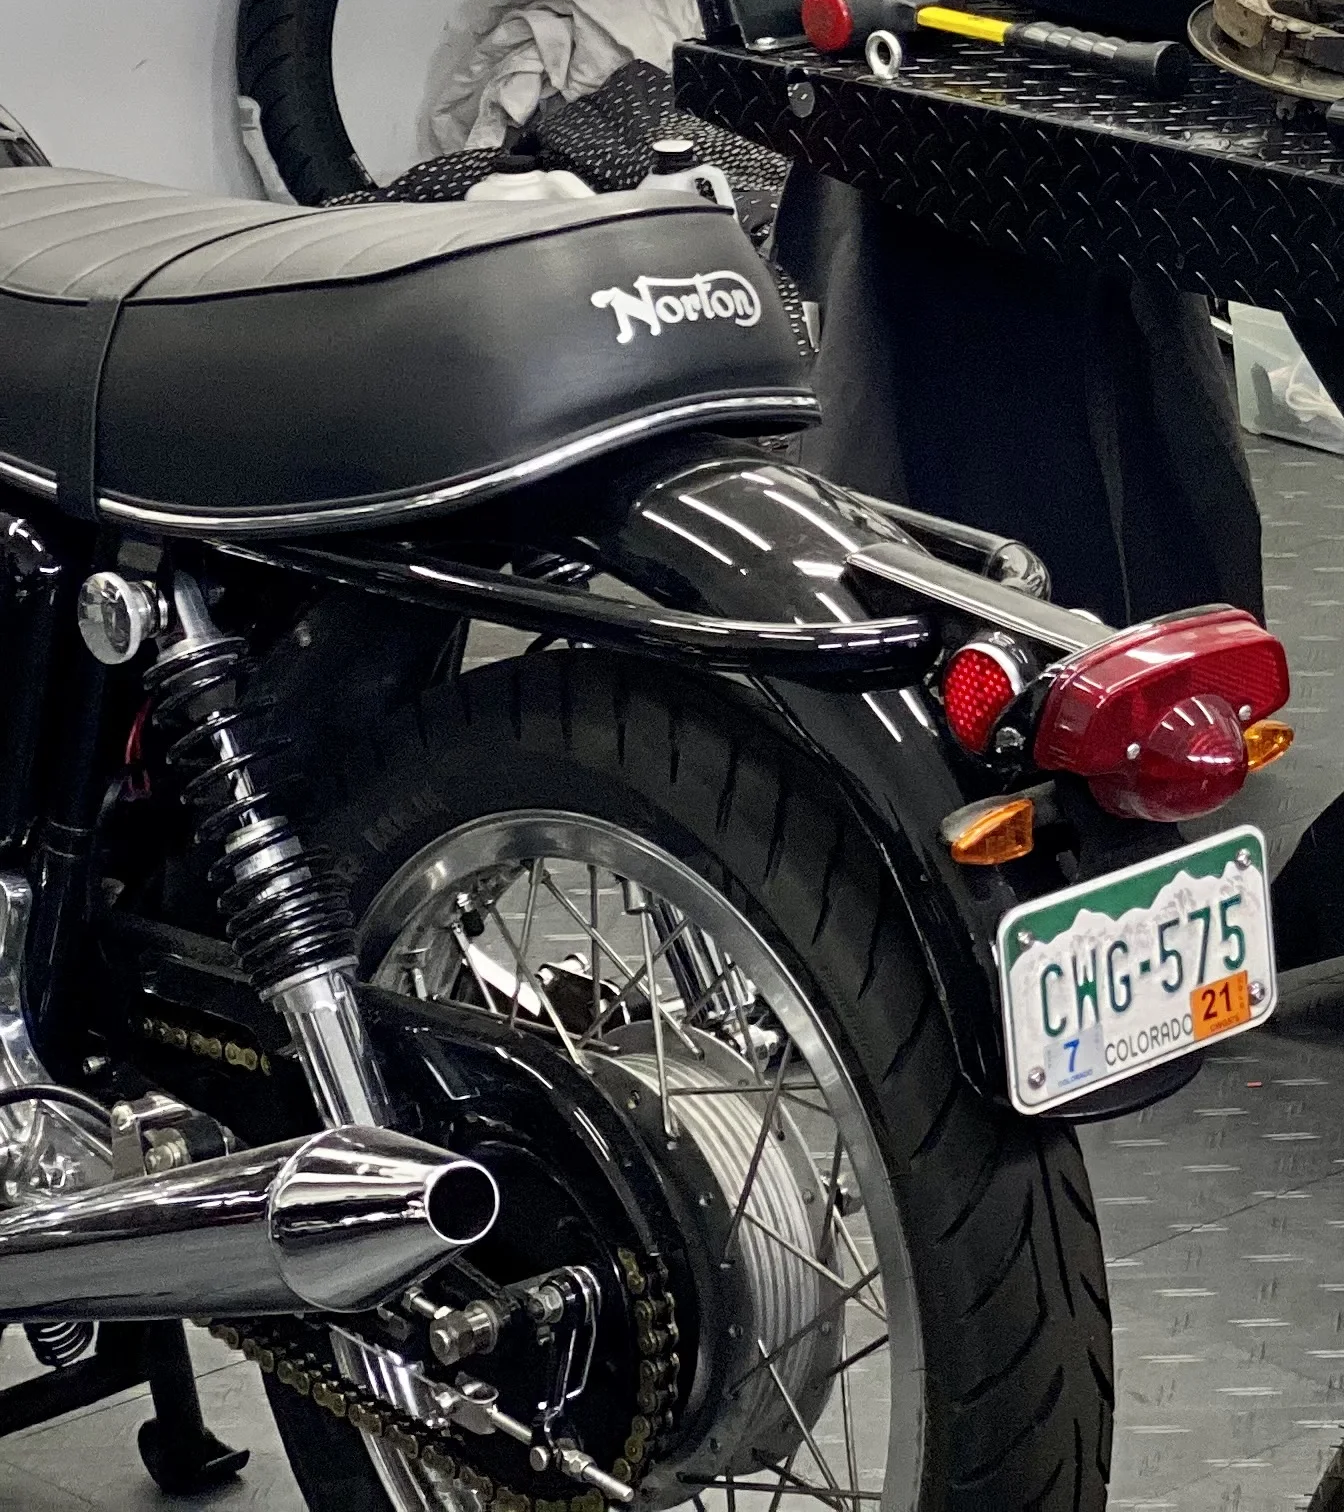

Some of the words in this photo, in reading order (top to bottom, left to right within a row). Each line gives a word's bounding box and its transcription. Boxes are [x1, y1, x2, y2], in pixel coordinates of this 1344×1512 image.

[590, 270, 762, 344] Norton
[1040, 893, 1246, 1038] CWG-575
[1201, 981, 1232, 1022] 21
[1063, 1038, 1080, 1073] 7
[1104, 1012, 1194, 1066] COLORADO
